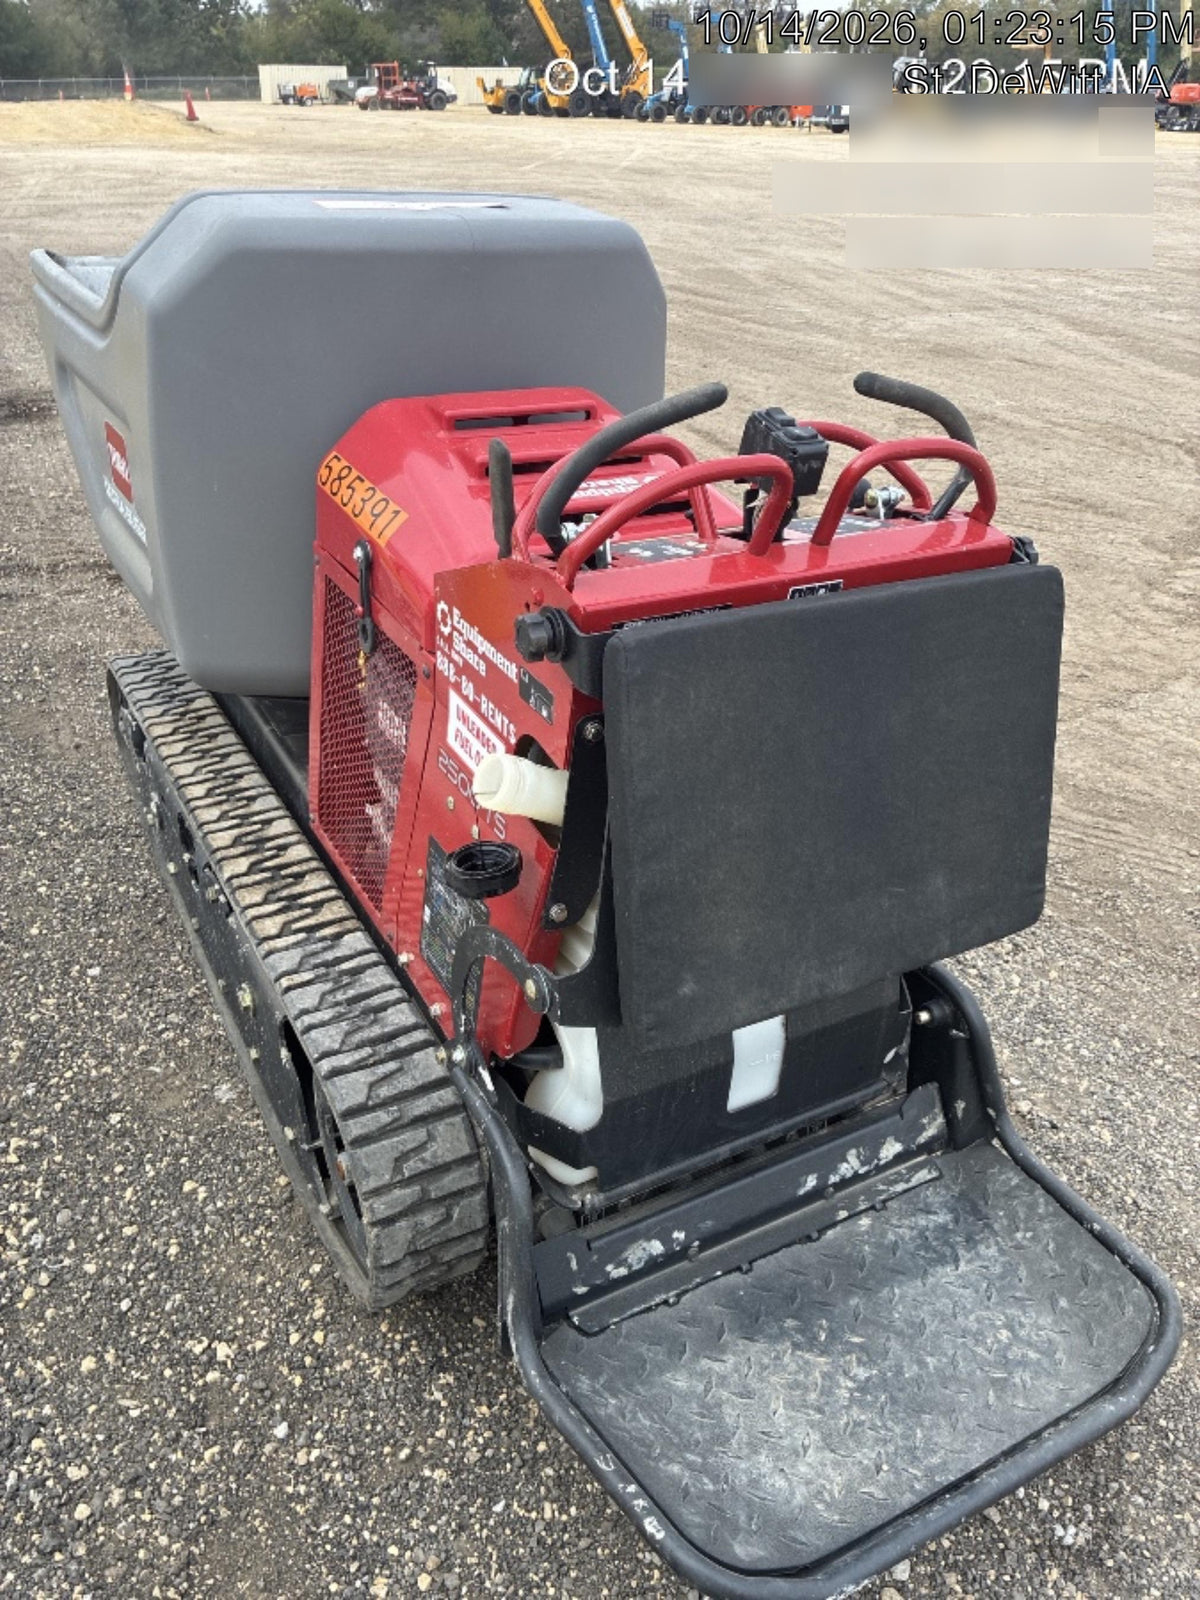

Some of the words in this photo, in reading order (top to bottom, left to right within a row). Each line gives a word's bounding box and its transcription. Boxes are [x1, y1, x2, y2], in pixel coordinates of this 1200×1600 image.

[320, 455, 401, 539] 585391
[452, 605, 518, 684] Equipment
[452, 629, 486, 678] Share
[454, 727, 474, 761] FUEL
